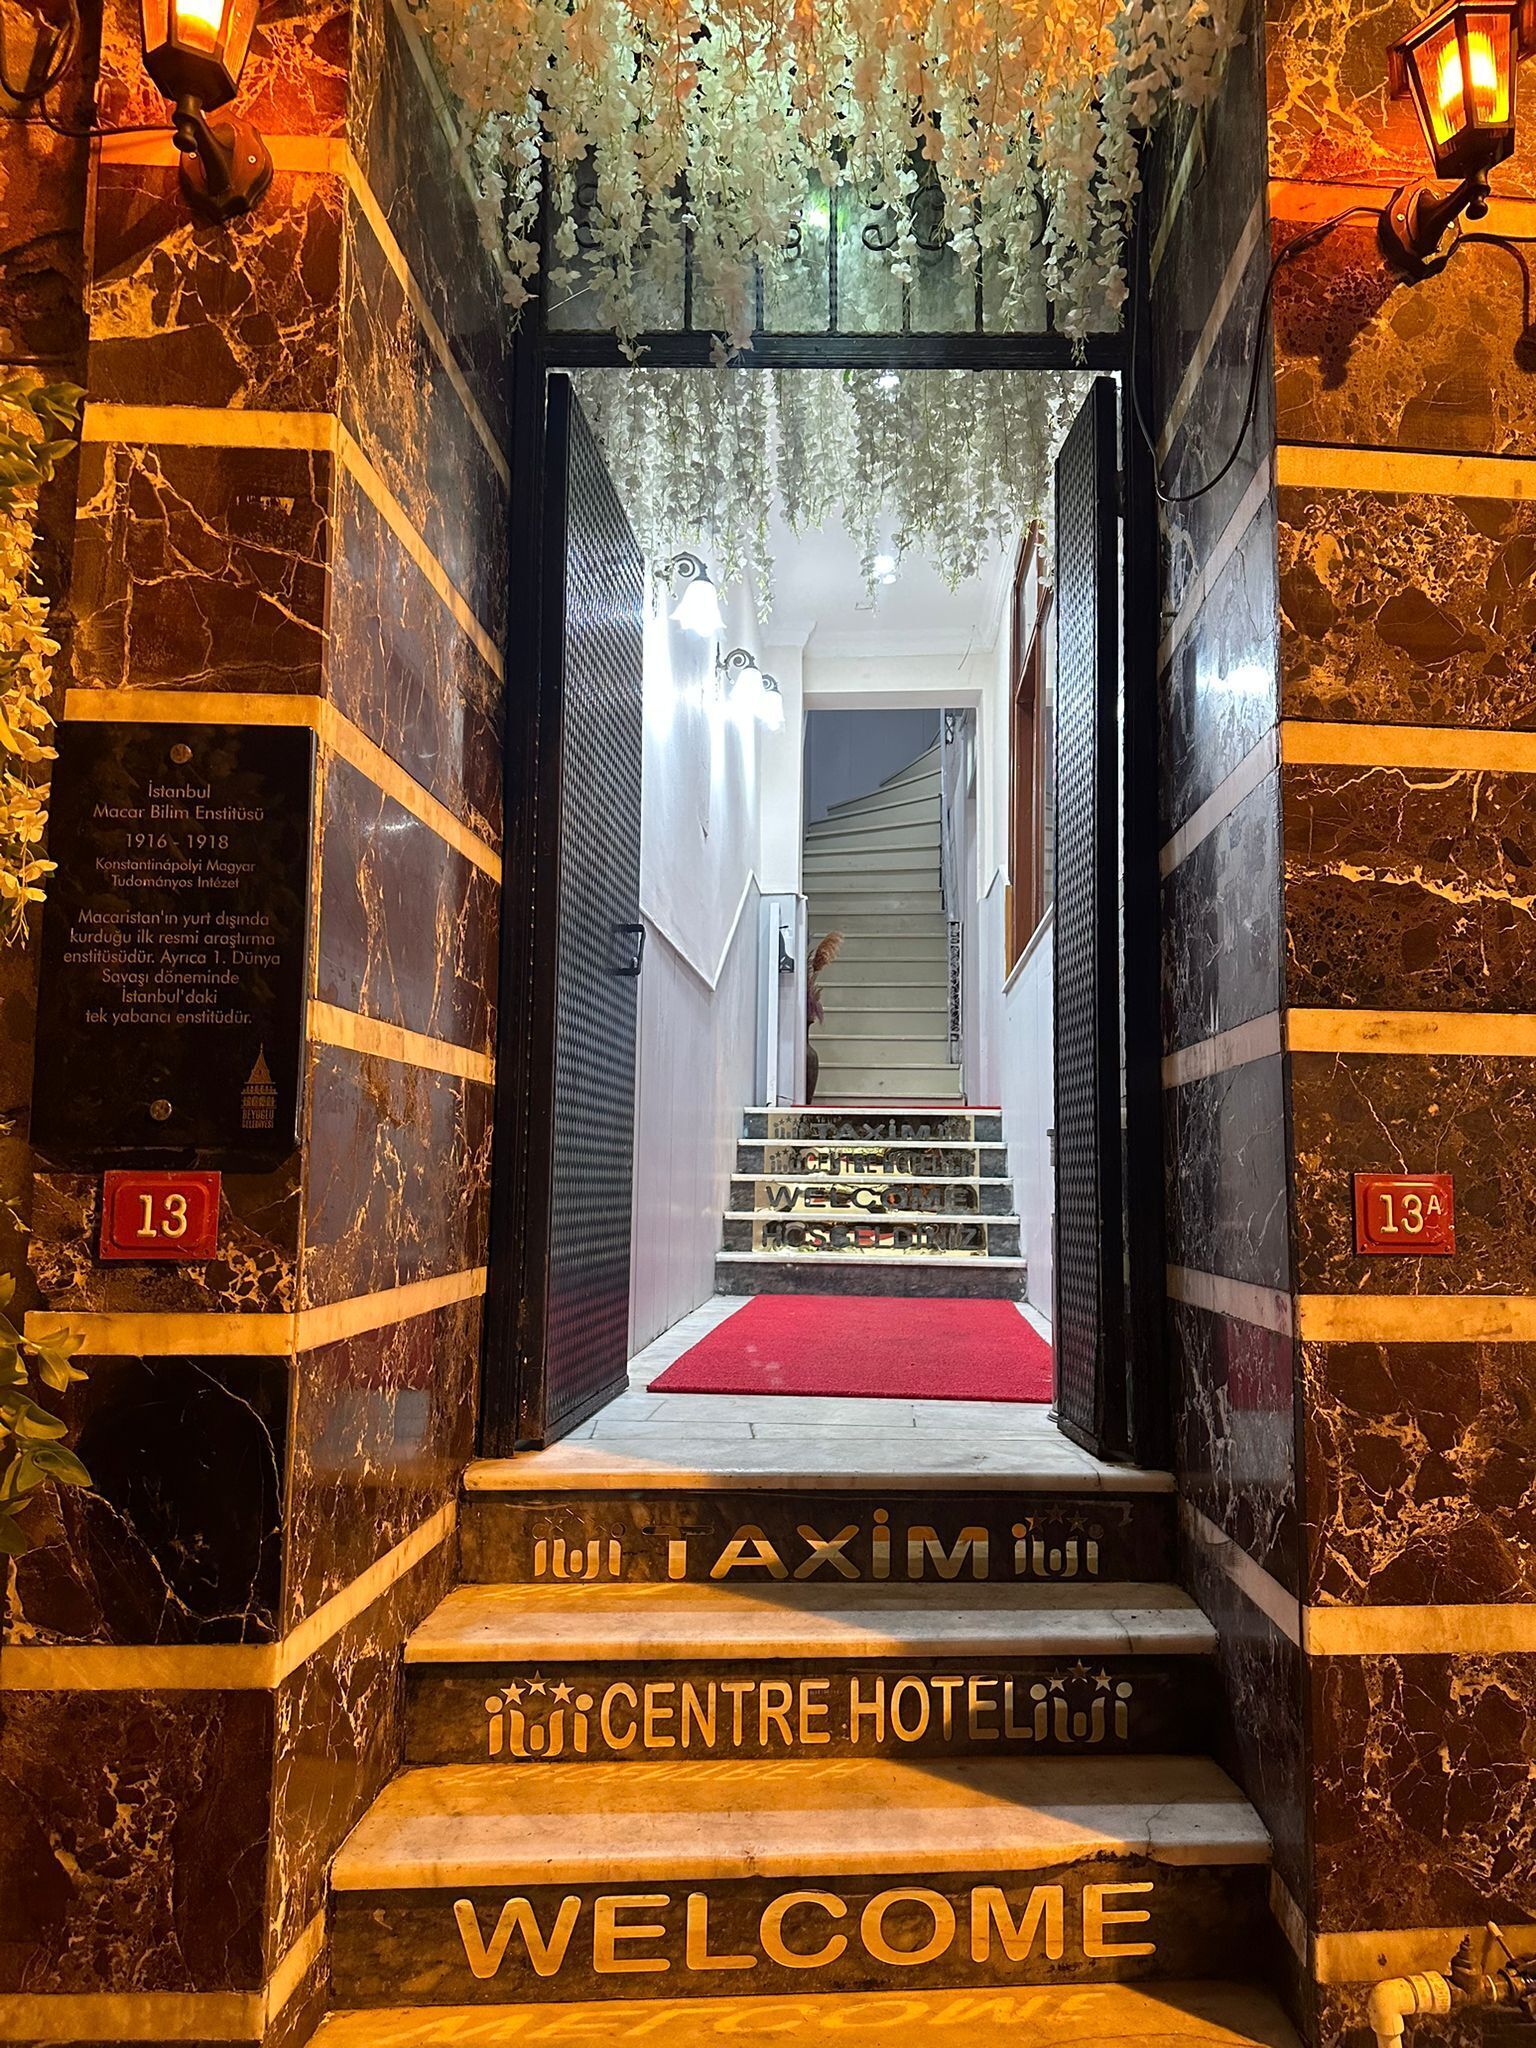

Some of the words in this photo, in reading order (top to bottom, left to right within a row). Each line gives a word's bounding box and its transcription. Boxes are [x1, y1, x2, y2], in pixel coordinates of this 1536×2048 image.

[148, 779, 211, 800] İstanbul
[93, 803, 145, 819] Macar
[151, 804, 189, 820] Bilim
[195, 805, 265, 822] Enstitüsü
[126, 833, 167, 849] 1916
[187, 834, 229, 850] 1918
[96, 857, 202, 874] Konstantinápolyi
[207, 859, 256, 875] Magyar
[111, 874, 193, 890] Tudományos
[78, 908, 178, 926] Macaristan'ın
[183, 911, 211, 928] yurt
[216, 910, 270, 930] dışında
[70, 928, 132, 947] kurduğu
[137, 929, 154, 944] ilk
[159, 931, 199, 945] resmi
[204, 932, 275, 949] araştırma
[63, 948, 155, 964] enstitüsüdür.
[160, 950, 207, 967] Ayrıca
[215, 951, 226, 965] 1.
[232, 951, 281, 968] Dünya
[102, 969, 149, 987] Savaşı
[154, 969, 240, 985] döneminde
[121, 984, 218, 1004] İstanbul'daki
[85, 1008, 107, 1023] tek
[112, 1009, 171, 1028] yabancı
[175, 1009, 253, 1025] enstitüdür.
[765, 1185, 972, 1210] WELCOME
[137, 1193, 187, 1238] 13
[1379, 1194, 1442, 1234] 13A
[600, 1679, 830, 1750] CENTRE
[850, 1674, 1035, 1743] HOTEL
[453, 1882, 1158, 1979] WELCOME
